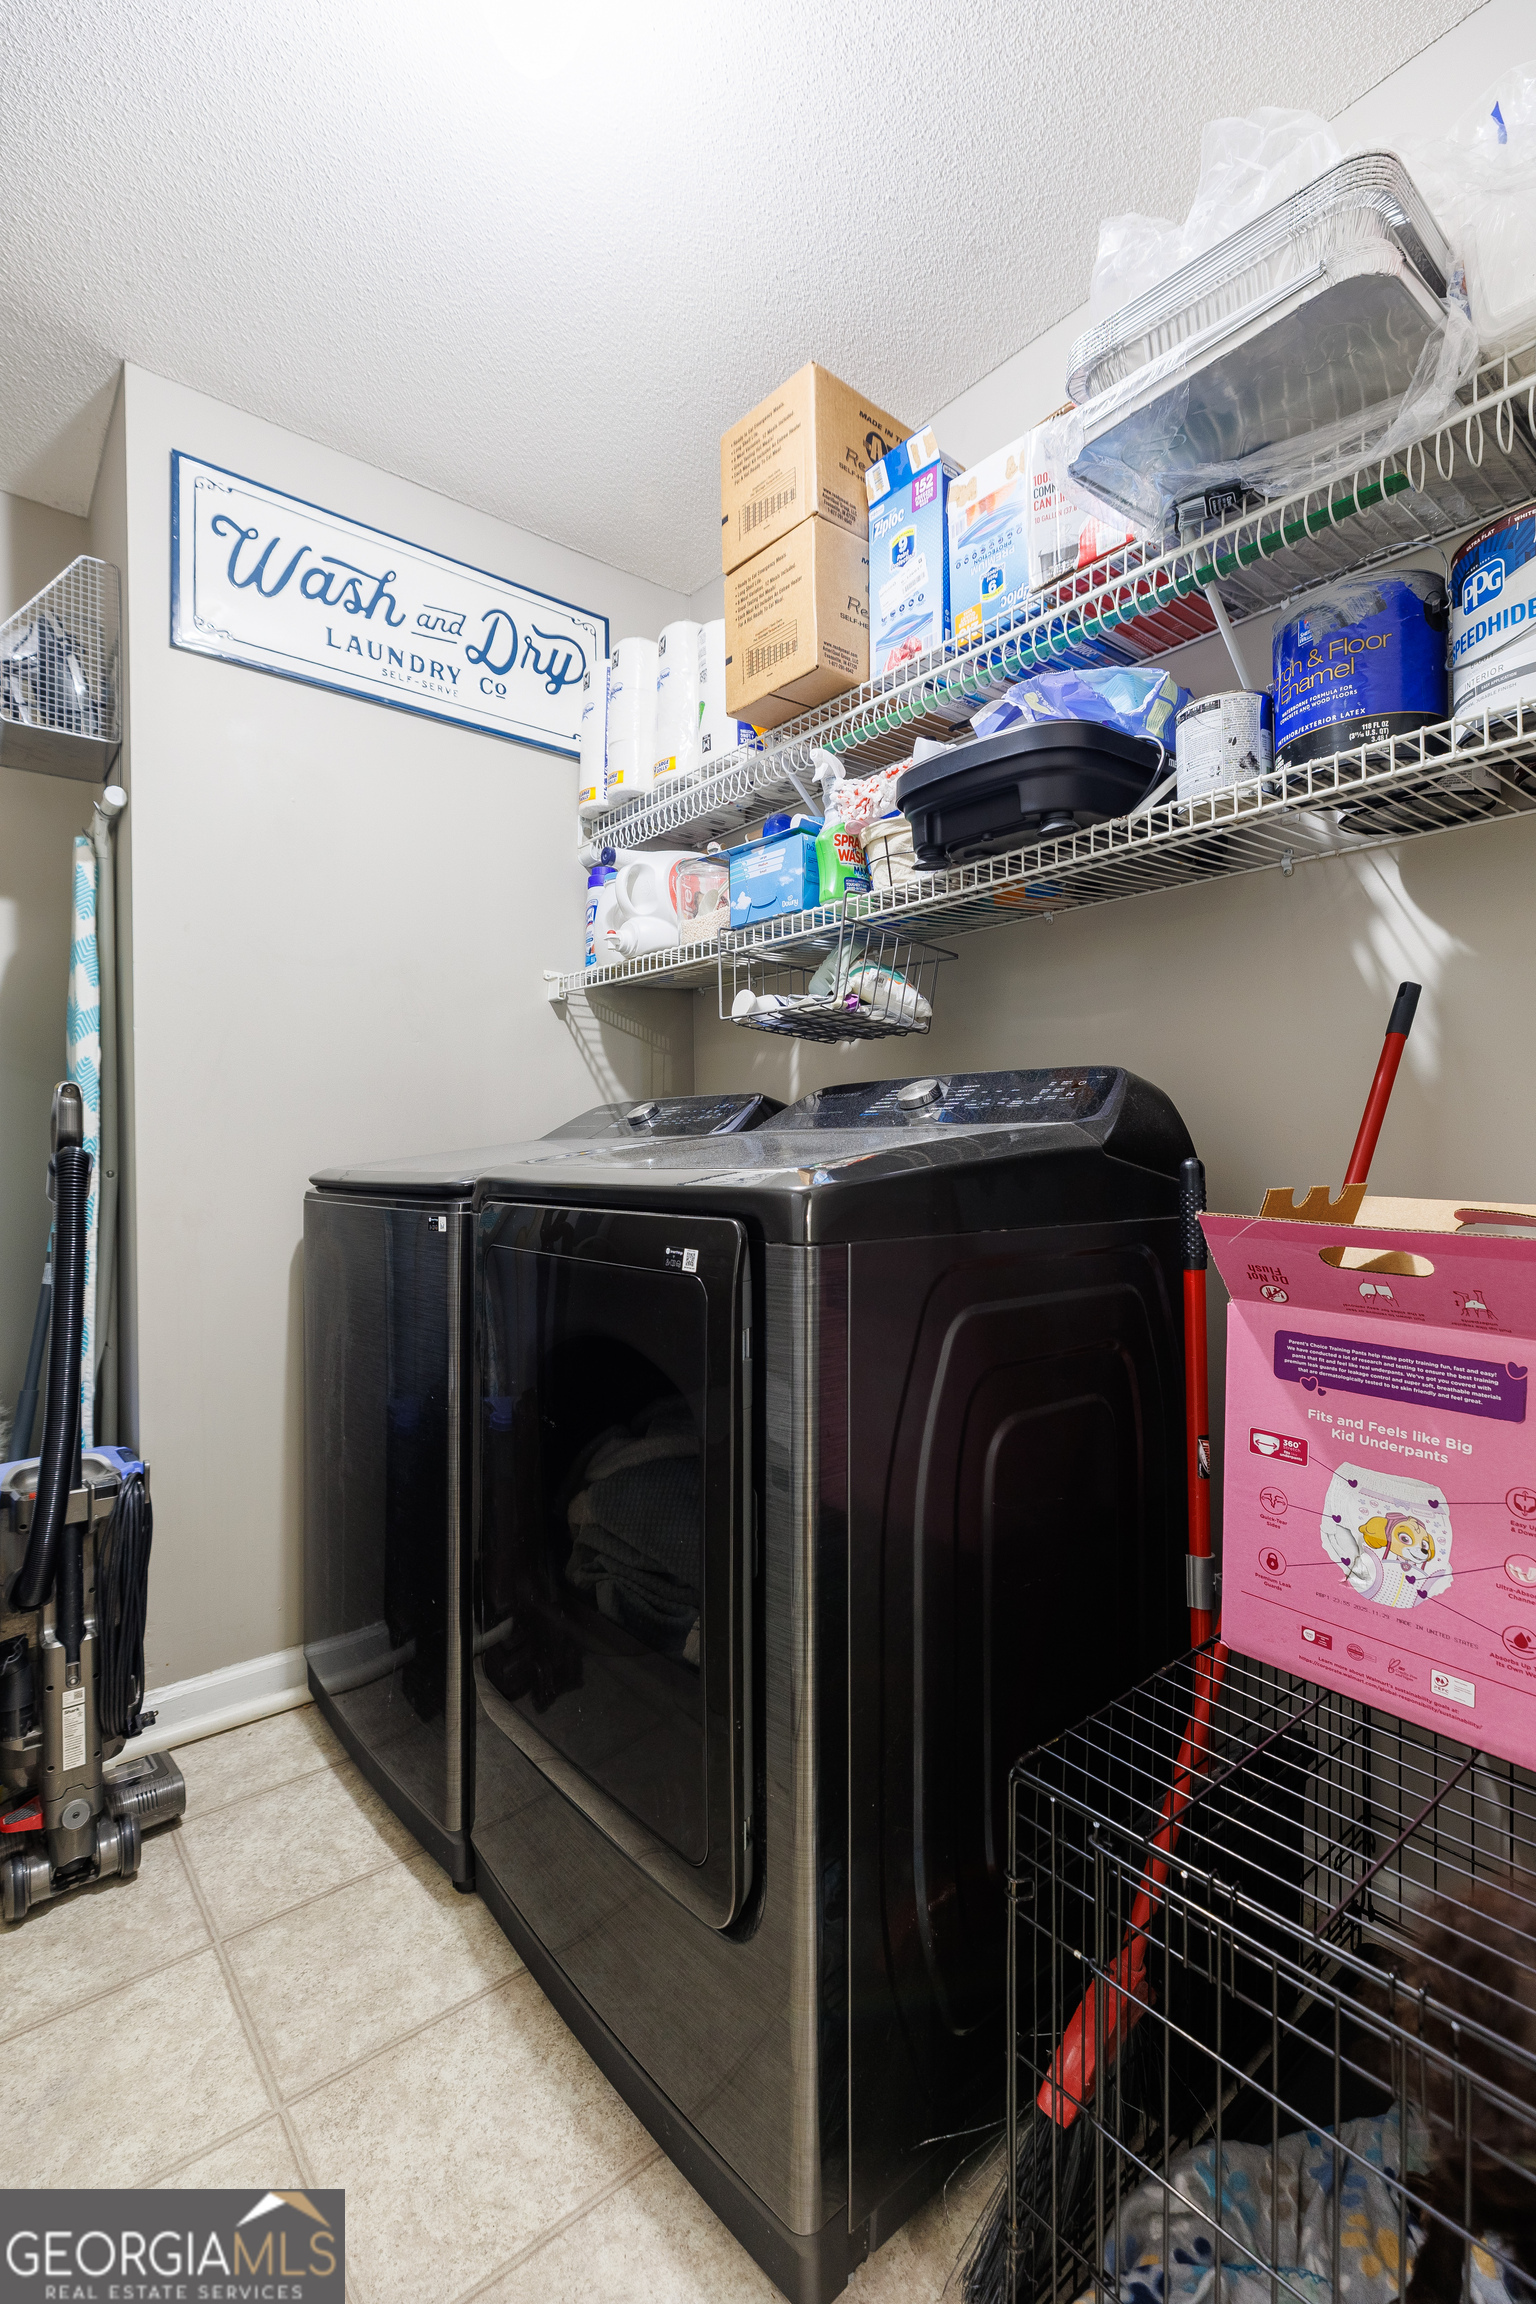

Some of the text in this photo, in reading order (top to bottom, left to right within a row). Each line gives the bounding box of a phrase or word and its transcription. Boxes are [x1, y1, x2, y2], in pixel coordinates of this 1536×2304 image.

[859, 410, 894, 438] MADE IN
[914, 473, 933, 496] 152
[1033, 494, 1051, 512] CAN
[874, 508, 904, 538] Ziploc
[974, 540, 1012, 565] PROTECTION
[1466, 538, 1480, 551] ULTRA
[1481, 528, 1495, 540] FLAT
[970, 545, 1015, 576] PREMIUM
[1464, 567, 1501, 608] PPG
[211, 514, 586, 695] Wash and Dry
[325, 627, 461, 685] LAUNDRY
[1307, 648, 1324, 668] &
[1328, 633, 1393, 660] Floor
[382, 668, 459, 697] SELF-SERVE
[1280, 657, 1355, 705] Enamel
[1464, 664, 1504, 691] INTERIOR
[1280, 689, 1358, 725] CONCRETE AND WOOD FLOORS
[1281, 684, 1353, 718] WATERBORNE FORMULA FOR
[1277, 714, 1337, 747] INTERIOR/EXTERIOR
[1340, 708, 1366, 719] LATEX
[1381, 720, 1389, 728] OZ
[834, 834, 861, 850] SPRA
[838, 848, 867, 866] WASH
[782, 899, 798, 908] Downy
[1247, 1264, 1282, 1276] Flush
[1247, 1272, 1289, 1285] Do Not
[1288, 1339, 1309, 1347] Parent's
[1309, 1342, 1328, 1350] Choice
[1328, 1345, 1351, 1355] Training
[1351, 1349, 1367, 1357] Pants
[1367, 1352, 1381, 1360] help
[1381, 1354, 1397, 1362] make
[1397, 1357, 1414, 1365] potty
[1415, 1359, 1439, 1369] training
[1439, 1363, 1452, 1371] fun,
[1479, 1370, 1497, 1378] easy!
[1291, 1353, 1306, 1361] pants
[1370, 1367, 1404, 1377] underpants.
[1405, 1372, 1424, 1381] We've
[1450, 1380, 1476, 1389] covered
[1476, 1384, 1492, 1392] with
[1309, 1349, 1337, 1359] conducted
[1358, 1357, 1382, 1366] research
[1383, 1361, 1395, 1369] and
[1395, 1363, 1416, 1373] testing
[1424, 1368, 1445, 1377] ensure
[1473, 1377, 1499, 1387] training
[1284, 1359, 1306, 1367] premium
[1319, 1365, 1338, 1373] guards
[1347, 1369, 1369, 1379] leakage
[1370, 1373, 1391, 1382] control
[1403, 1379, 1420, 1387] super
[1421, 1382, 1435, 1390] soft,
[1436, 1385, 1470, 1395] breathable
[1471, 1390, 1501, 1401] materials
[1318, 1371, 1364, 1385] dermatologically
[1364, 1379, 1383, 1388] tested
[1413, 1388, 1436, 1399] friendly
[1463, 1397, 1482, 1406] great.
[1308, 1408, 1473, 1455] Fits and Feels like Big
[1331, 1428, 1449, 1463] Kid Underpants
[1260, 1513, 1287, 1526] Quick-Tear
[1266, 1521, 1281, 1529] Sides
[1510, 1519, 1528, 1531] Easy
[1254, 1572, 1278, 1583] Premium
[1263, 1581, 1282, 1591] Guards
[1395, 1616, 1479, 1650] MADE IN UNITED STATES
[1489, 1652, 1532, 1671] Absorbs Up
[1496, 1660, 1524, 1675] Its Own
[1317, 1655, 1333, 1666] Learn
[1333, 1662, 1348, 1672] more
[1348, 1667, 1365, 1679] about
[1365, 1674, 1394, 1690] Walmart's
[1394, 1685, 1433, 1706] sustainability
[1433, 1700, 1450, 1712] goals
[1450, 1707, 1459, 1715] at:
